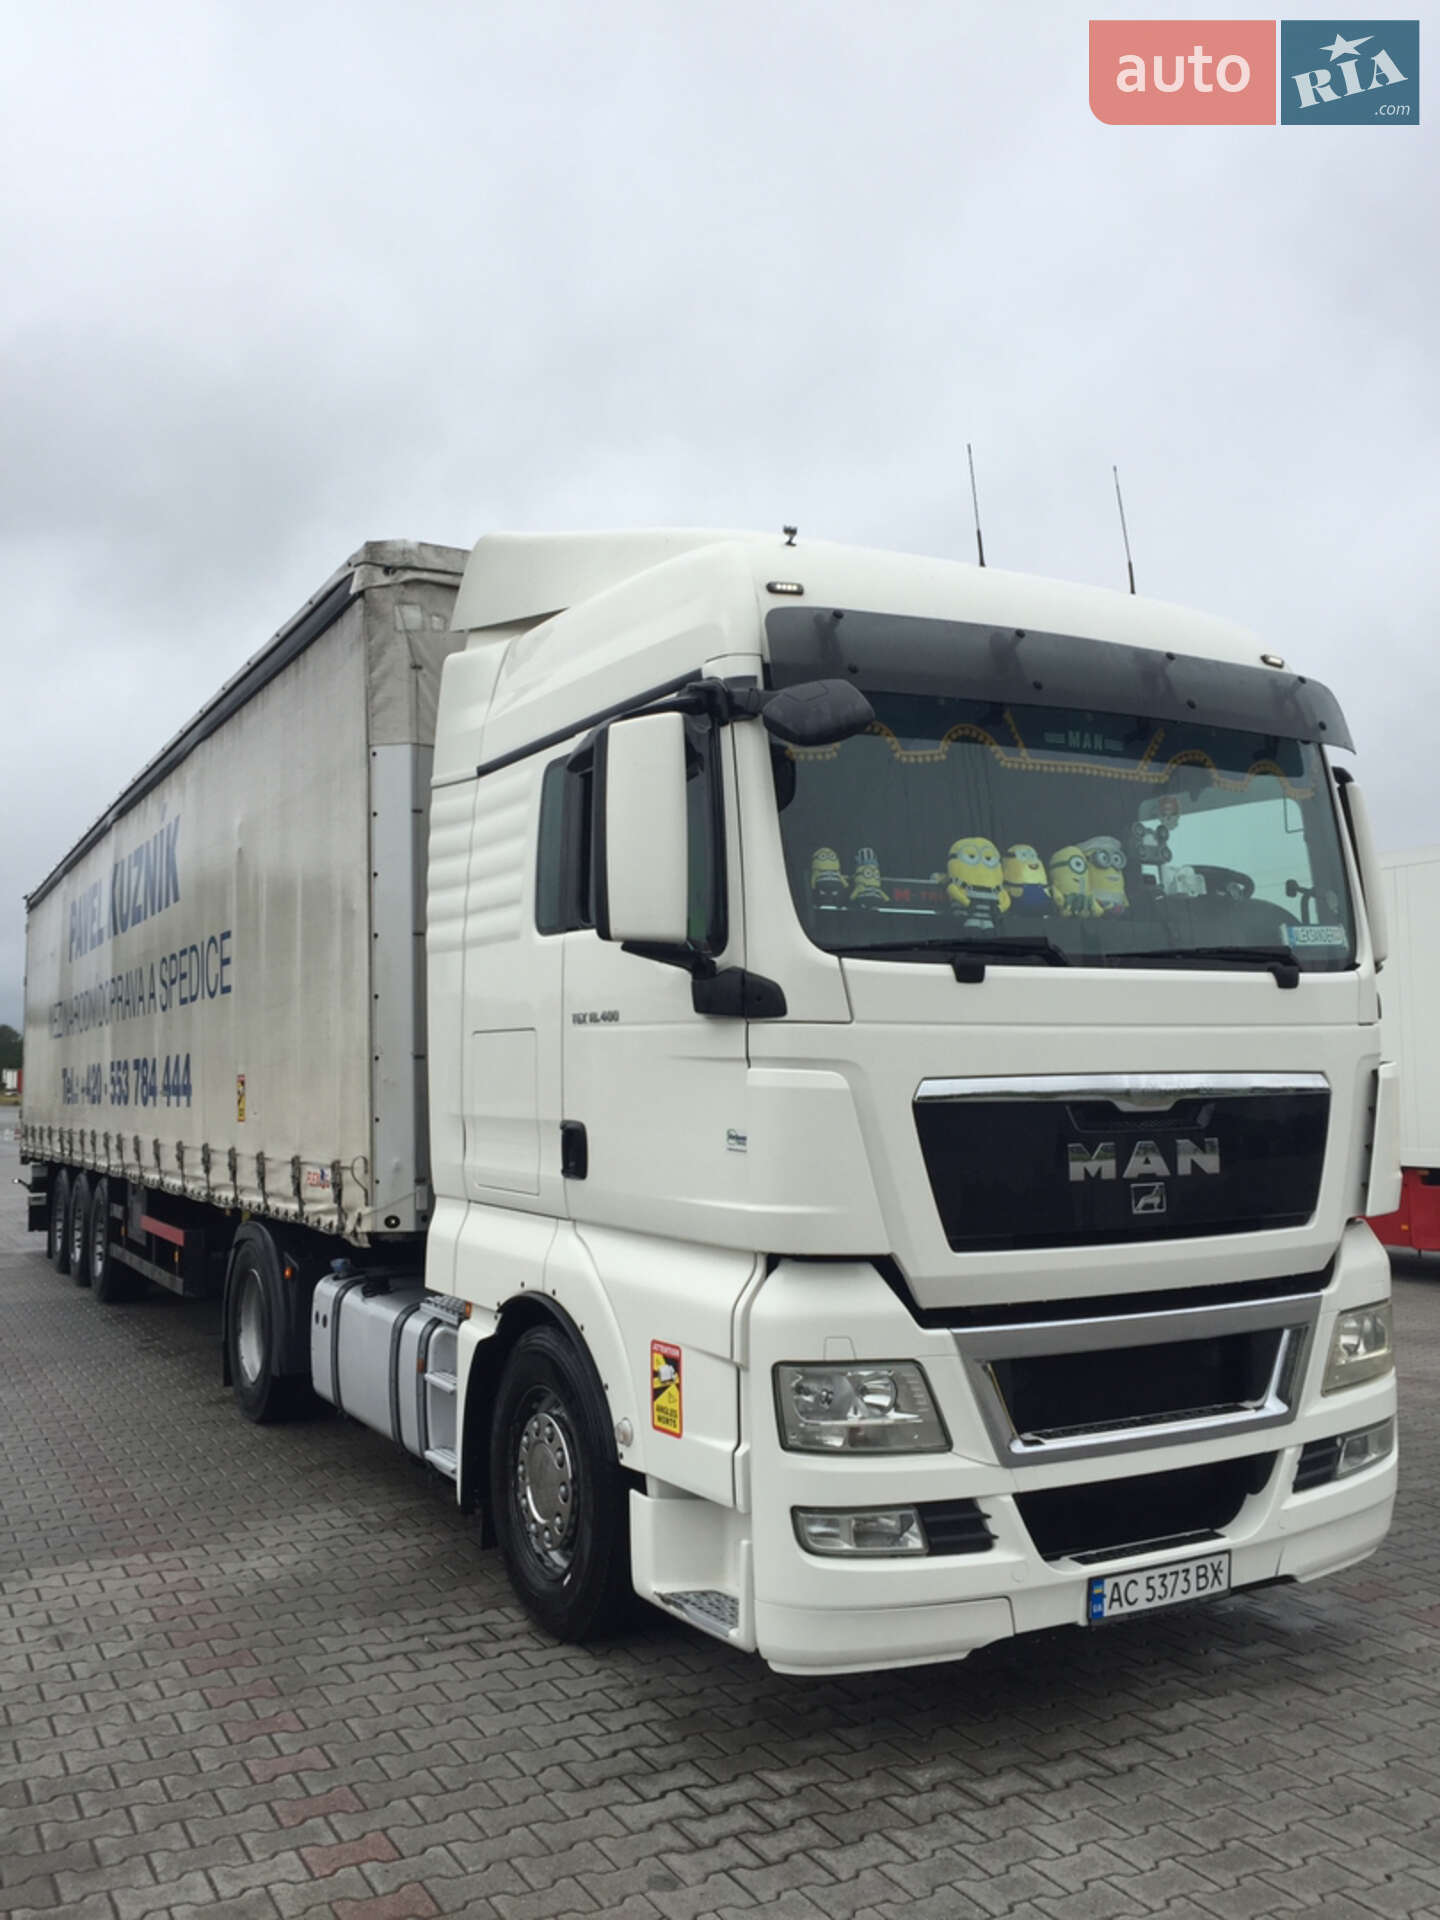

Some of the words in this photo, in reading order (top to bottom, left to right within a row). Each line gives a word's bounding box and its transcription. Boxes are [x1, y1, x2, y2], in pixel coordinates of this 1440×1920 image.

[160, 930, 231, 1012] SPEDICE
[110, 1060, 129, 1105] 553
[133, 1058, 157, 1107] 784
[162, 1052, 192, 1107] 444
[1067, 1137, 1220, 1181] MAN
[1108, 1579, 1138, 1610] AC
[1145, 1568, 1191, 1602] 5373
[1196, 1560, 1222, 1591] BX
